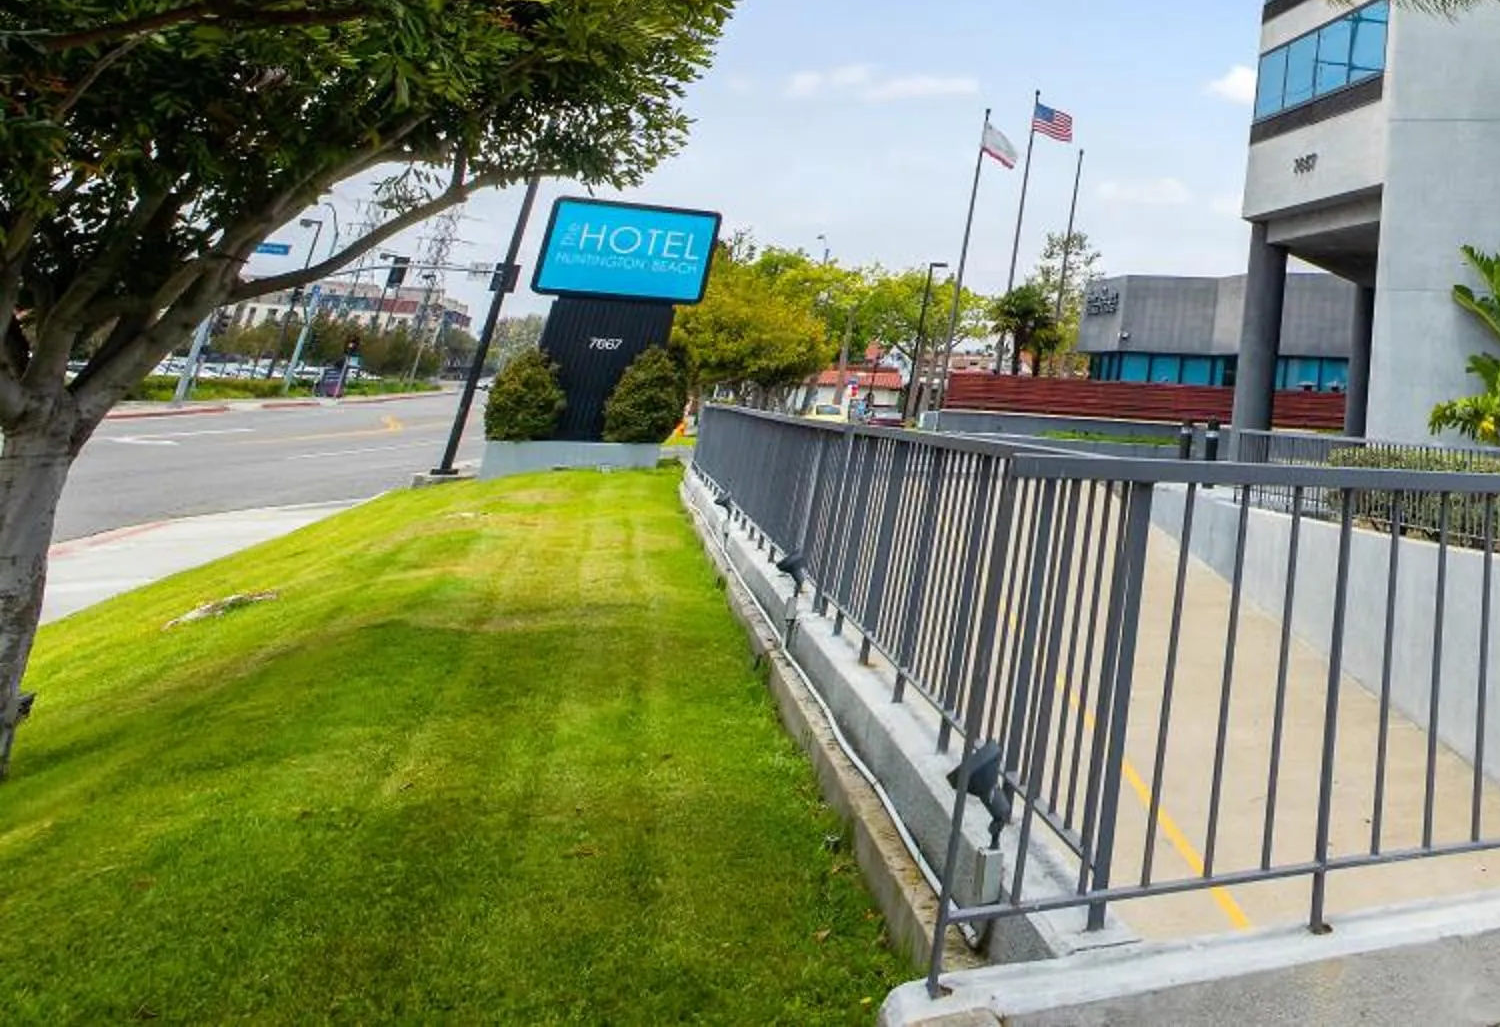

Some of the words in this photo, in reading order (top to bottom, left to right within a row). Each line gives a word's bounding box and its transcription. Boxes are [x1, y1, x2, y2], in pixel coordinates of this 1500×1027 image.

[578, 222, 700, 261] HOTEL
[555, 252, 645, 270] HUNTINGTON
[651, 259, 698, 275] BEACH
